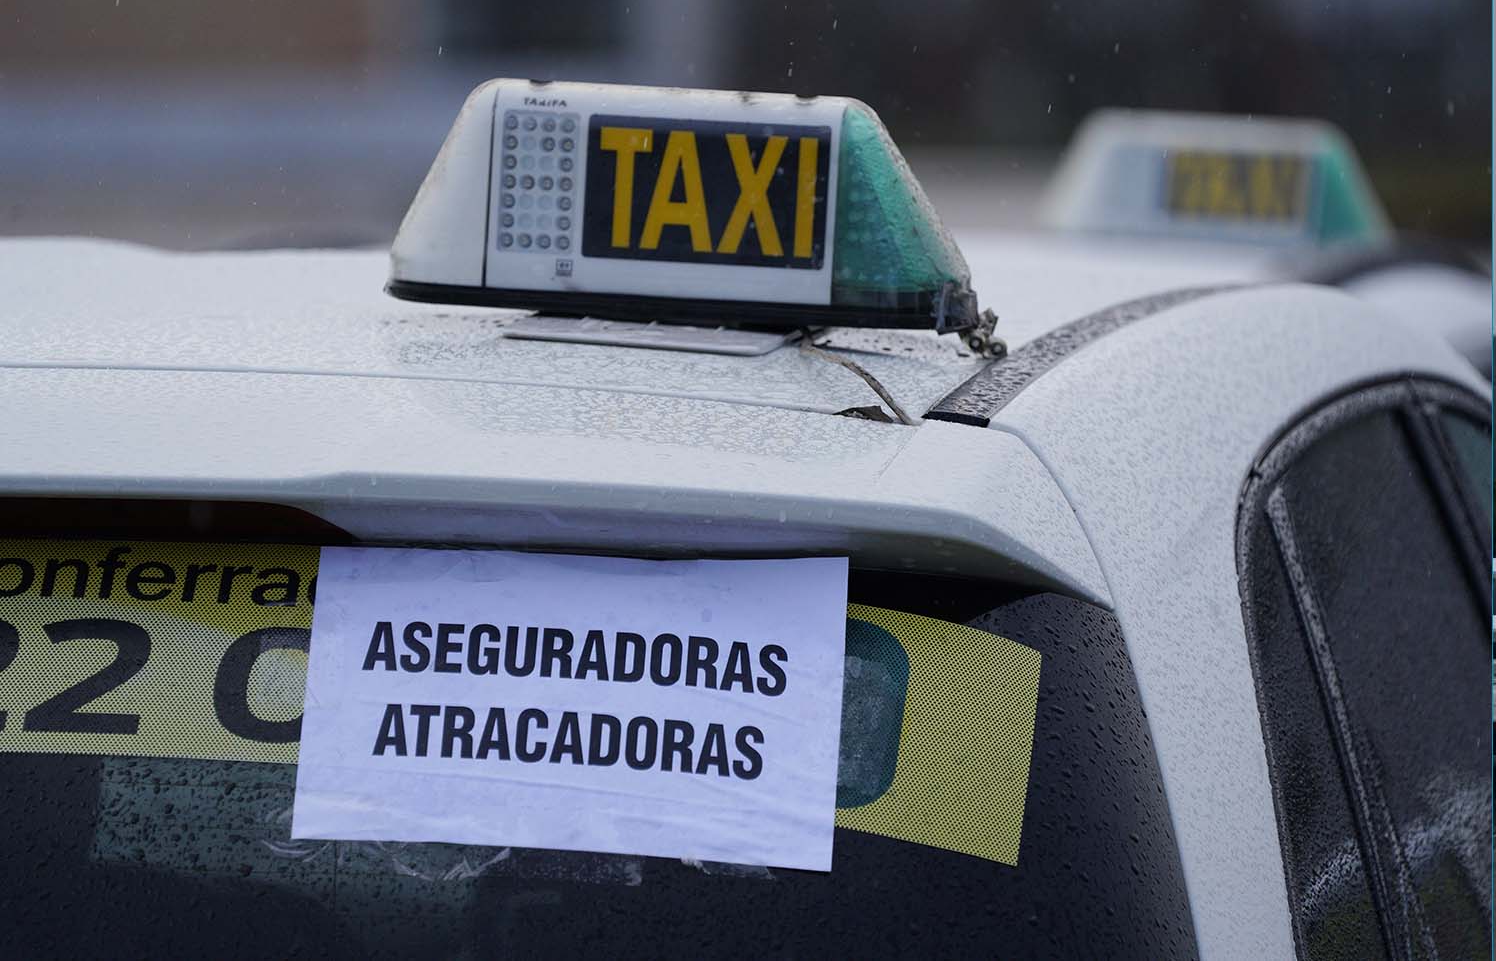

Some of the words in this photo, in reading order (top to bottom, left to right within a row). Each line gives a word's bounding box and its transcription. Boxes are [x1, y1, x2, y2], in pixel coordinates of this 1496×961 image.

[600, 126, 819, 258] TAXI
[0, 546, 317, 606] onferra
[362, 621, 788, 696] ASEGURADORAS
[372, 703, 765, 781] ATRACADORAS
